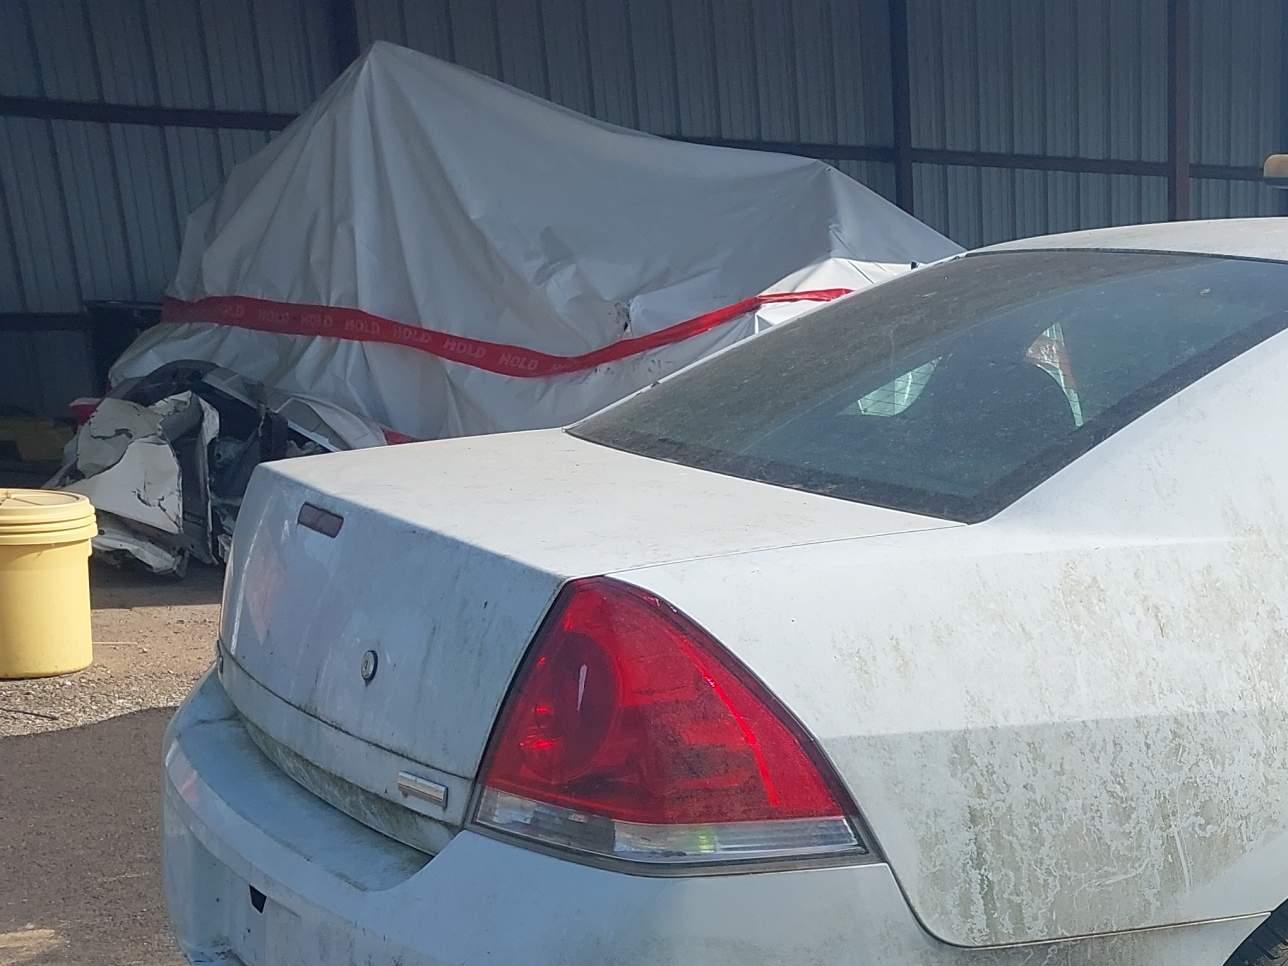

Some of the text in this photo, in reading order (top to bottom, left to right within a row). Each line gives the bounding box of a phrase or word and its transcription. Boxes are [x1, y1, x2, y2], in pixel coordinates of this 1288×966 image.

[344, 319, 380, 336] HOLD
[392, 326, 431, 344] HOLD
[443, 338, 487, 359] HOLD
[499, 352, 539, 371] HOLD
